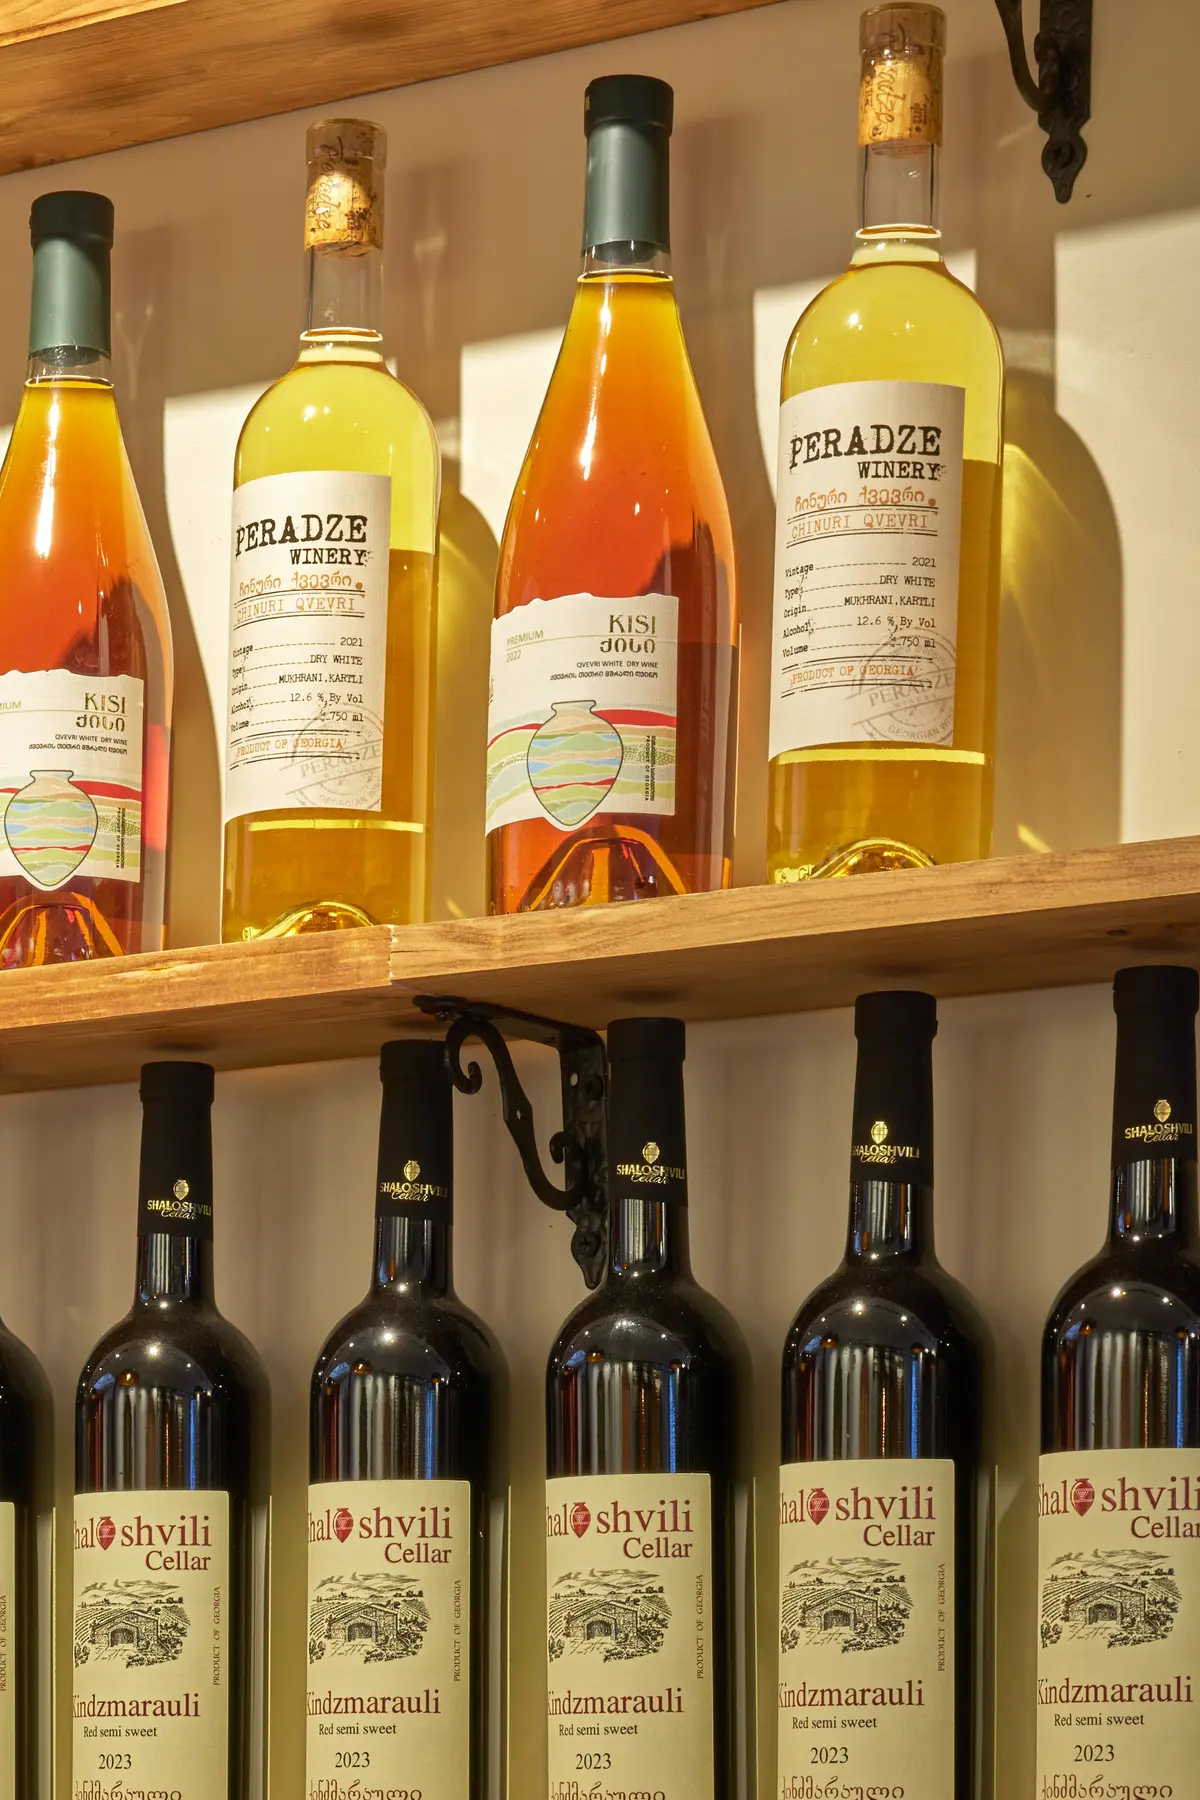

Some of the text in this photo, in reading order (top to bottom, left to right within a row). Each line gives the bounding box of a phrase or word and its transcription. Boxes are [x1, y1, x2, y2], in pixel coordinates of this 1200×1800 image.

[789, 424, 942, 470] PERADZE
[857, 461, 940, 480] WINERY
[235, 514, 368, 557] PERADZE
[791, 514, 928, 540] CHINURI QVEVRI
[290, 548, 366, 566] WINERY
[785, 557, 936, 579] Vintage 2021
[879, 575, 899, 585] DRY
[904, 576, 936, 588] WHITE
[236, 598, 354, 622] CHINURI QVEVRI
[783, 604, 807, 618] Origin
[609, 614, 656, 634] KISI
[856, 616, 881, 626] 12.6
[900, 616, 913, 628] By
[919, 618, 936, 628] Vol
[340, 637, 363, 647] 2021
[506, 630, 544, 646] PREMIUM
[506, 650, 522, 662] 2022
[782, 637, 936, 658] Volume 750 ml
[310, 654, 363, 666] DRY WHITE
[576, 661, 600, 669] QVEVRI
[601, 660, 623, 668] WHITE
[792, 664, 915, 685] PRODUCT OF GEORGIA
[84, 692, 126, 714] KISI
[79, 734, 128, 746] WHITE WINE
[293, 738, 343, 749] GEORGIA
[1124, 1122, 1193, 1139] SHALOSHVILI
[863, 1523, 936, 1547] Cellar
[384, 1542, 452, 1565] Cellar
[622, 1537, 693, 1559] Cellar
[145, 1550, 211, 1571] Cellar
[937, 1563, 946, 1672] PRODUCT OF GEORGIA
[1038, 1675, 1193, 1705] Kindzmarauli
[792, 1716, 877, 1730] Red semi sweet
[1053, 1712, 1145, 1727] Red semi sweet
[603, 1724, 638, 1736] sweet
[98, 1753, 132, 1771] 2023
[334, 1751, 371, 1769] 2023
[575, 1753, 612, 1771] 2023
[810, 1746, 850, 1765] 2023
[1074, 1744, 1115, 1762] 2023
